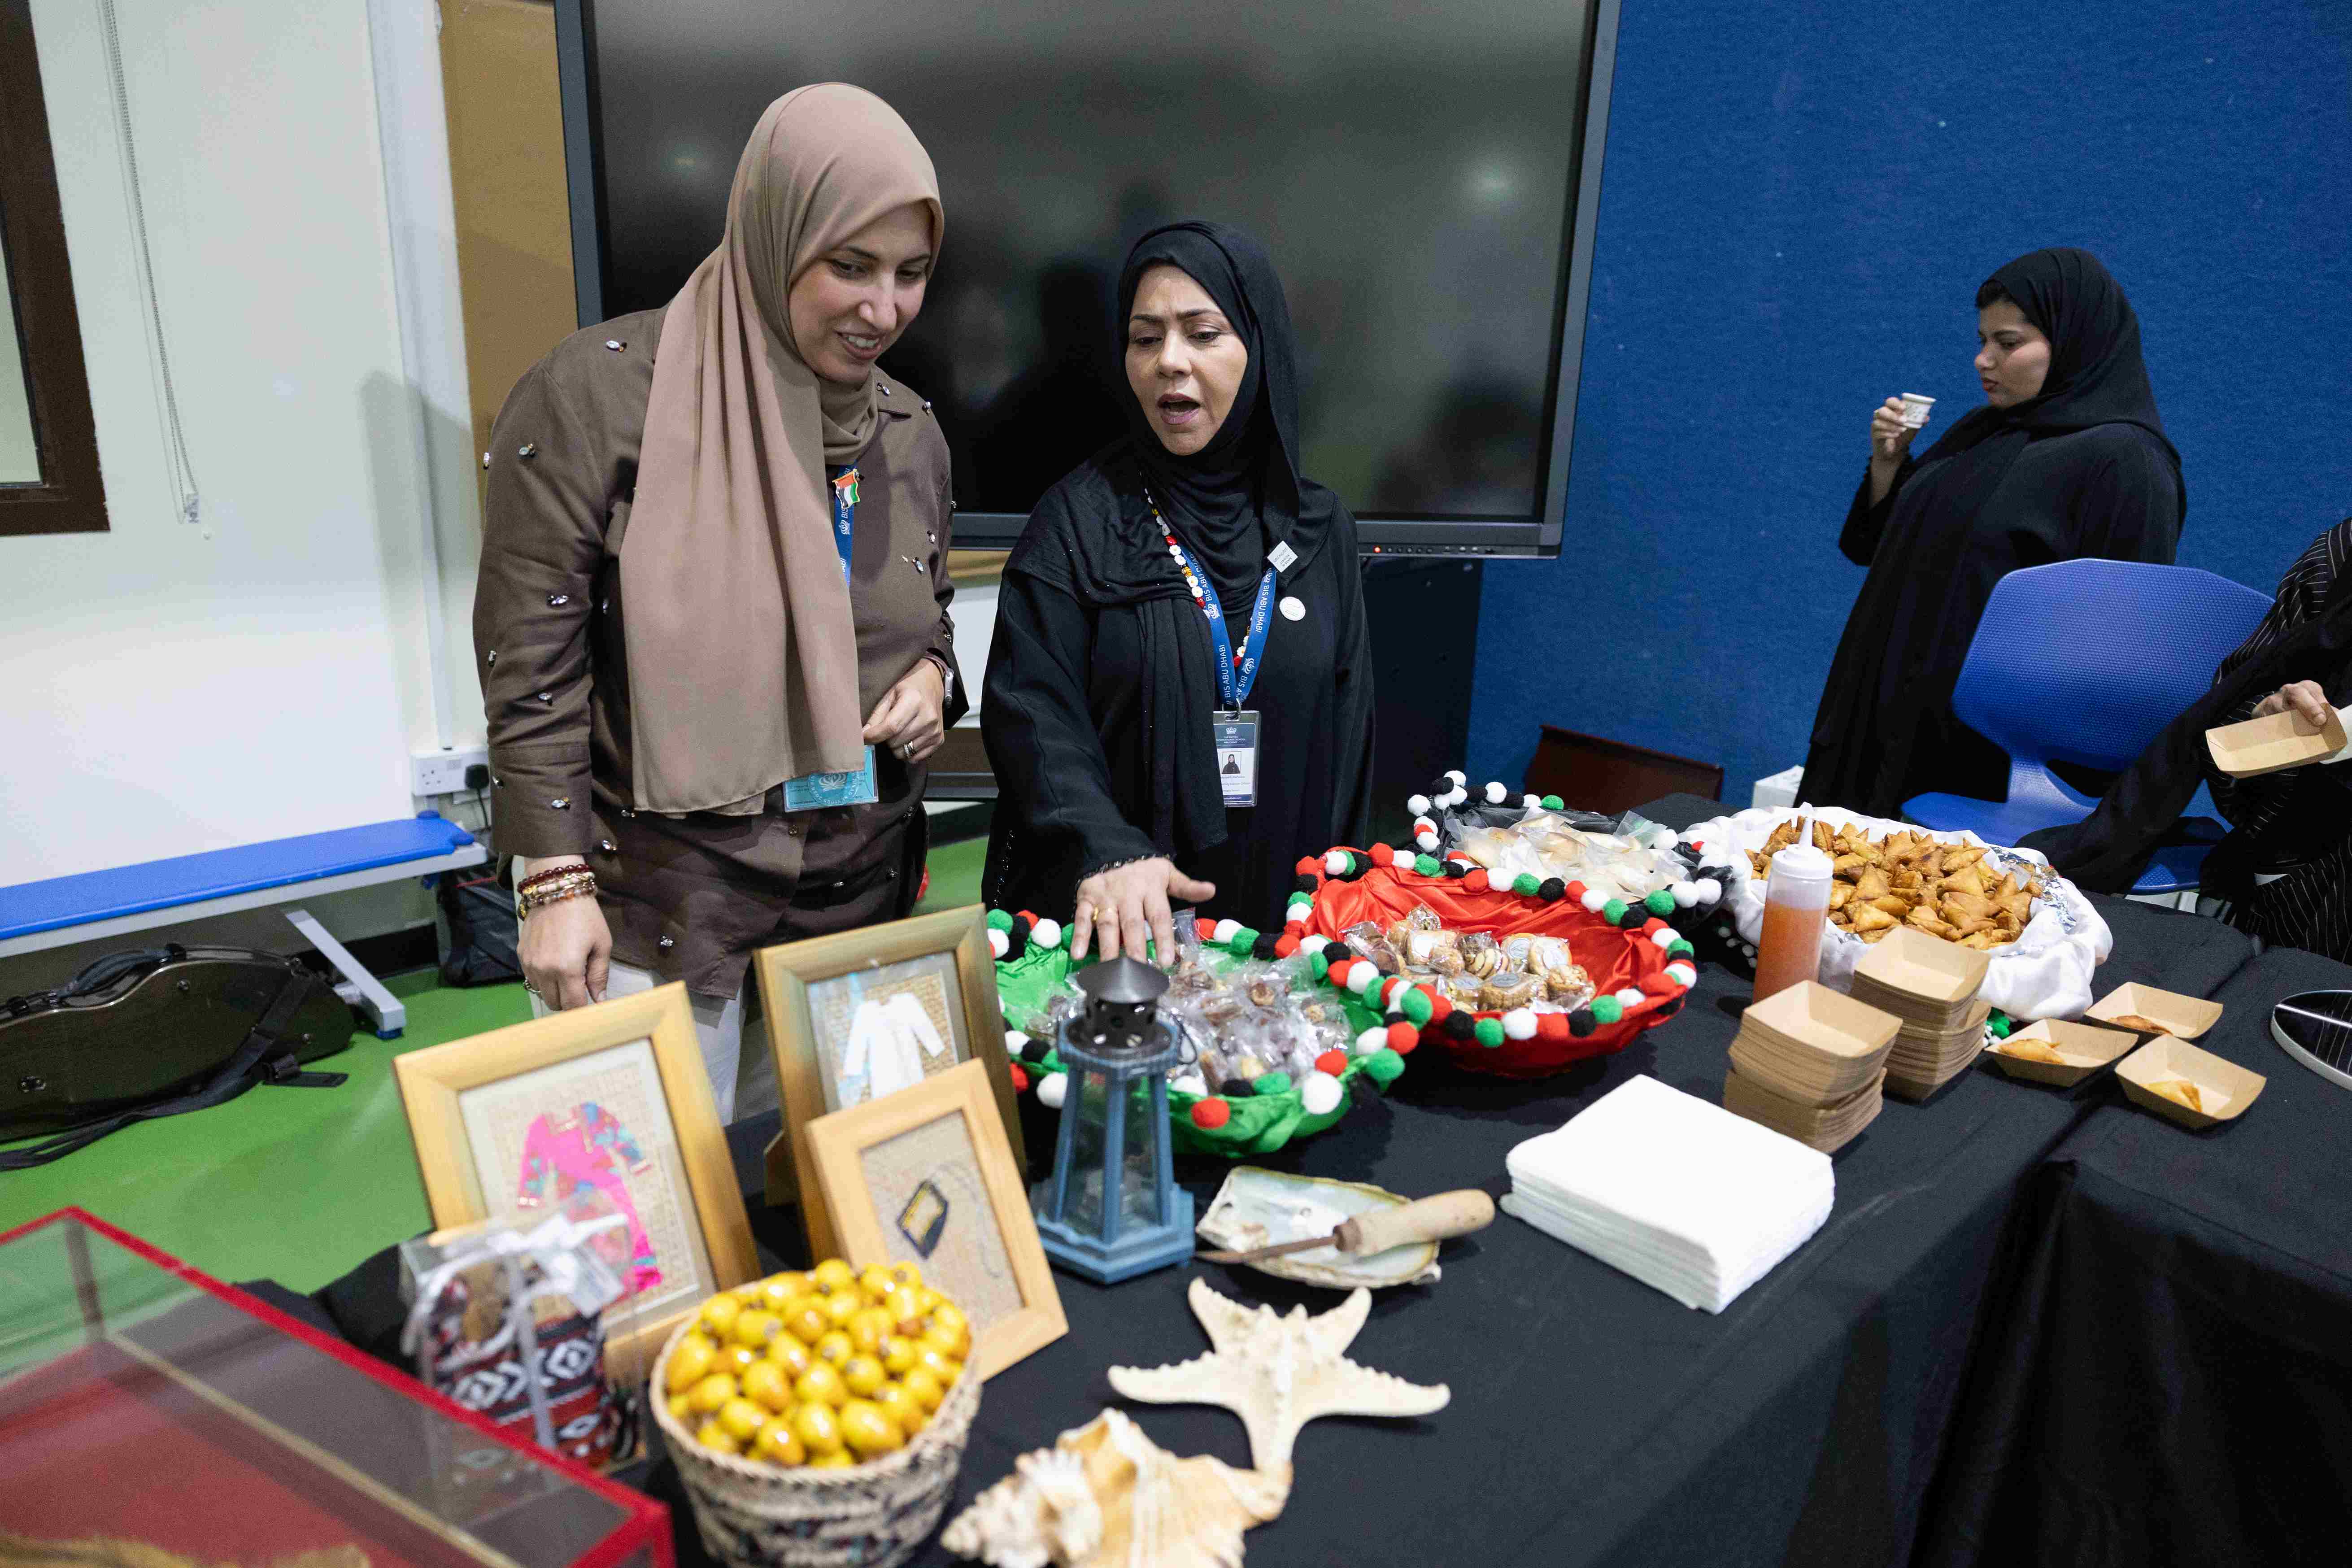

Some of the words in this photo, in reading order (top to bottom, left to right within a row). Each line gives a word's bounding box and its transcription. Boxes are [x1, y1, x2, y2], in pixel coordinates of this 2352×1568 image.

[1198, 574, 1208, 588] ABU
[1204, 589, 1212, 601] BIS
[1259, 597, 1268, 610] ABU
[1255, 612, 1265, 633] DHABI
[1219, 645, 1228, 667] DHABI
[1221, 669, 1230, 684] ABU
[1238, 675, 1248, 688] BIS
